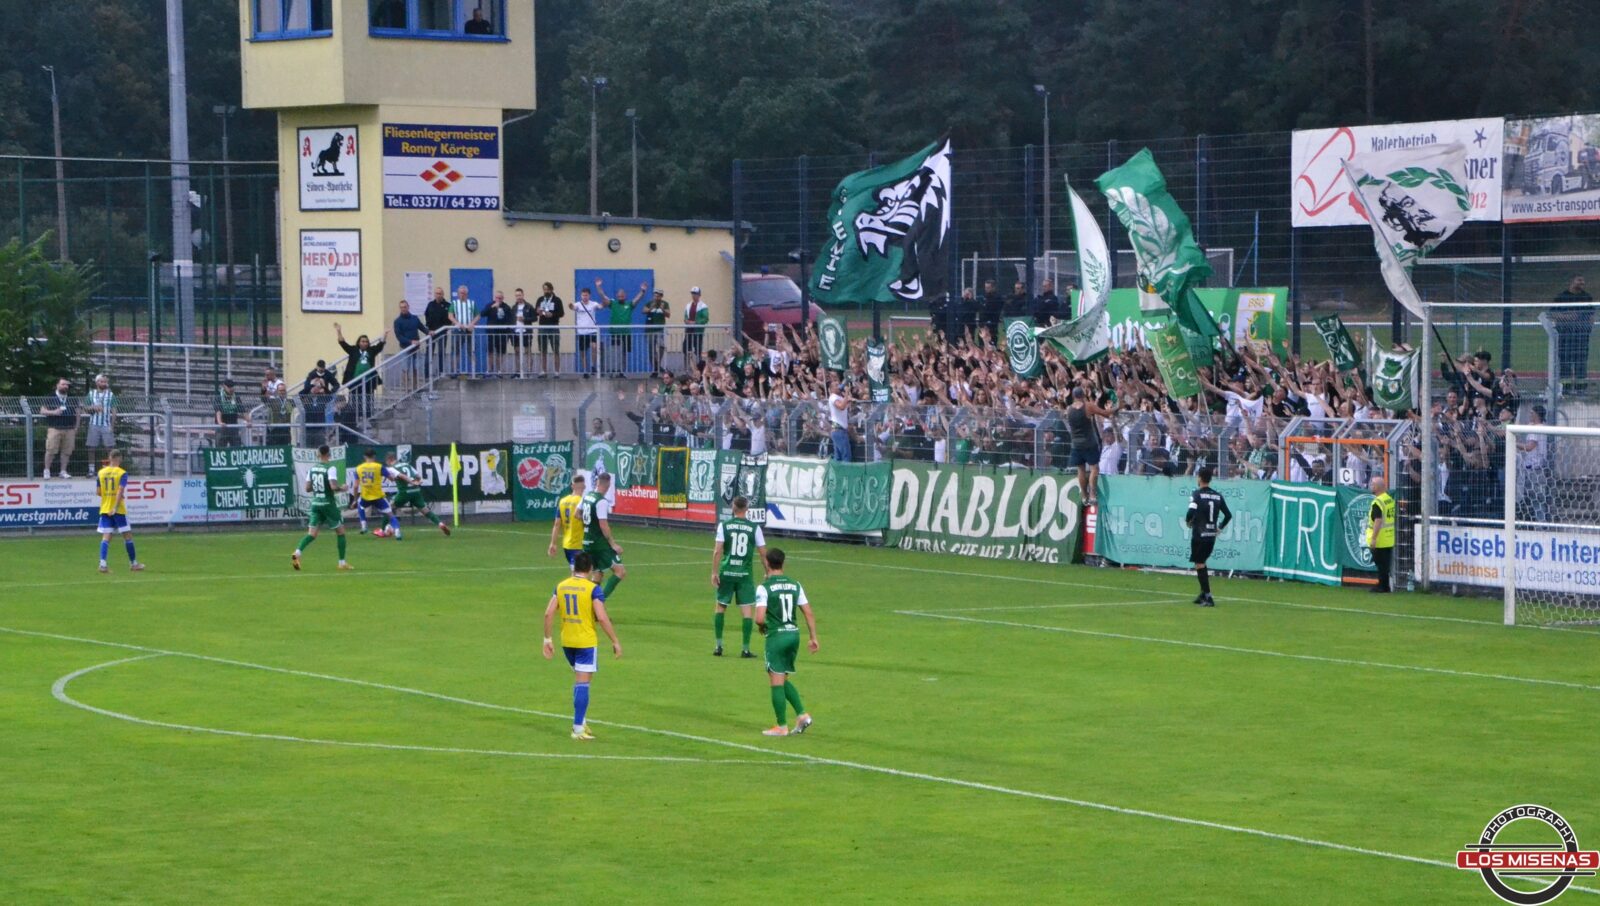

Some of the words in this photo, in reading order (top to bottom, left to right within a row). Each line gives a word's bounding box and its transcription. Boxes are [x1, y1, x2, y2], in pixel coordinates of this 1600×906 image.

[384, 126, 497, 142] Fliesenlegermeister
[401, 142, 437, 158] Ronny
[440, 143, 480, 159] Körtge
[385, 195, 409, 208] Tel.:
[411, 196, 449, 209] 03371/
[451, 197, 465, 208] 64
[467, 197, 482, 209] 29
[483, 198, 498, 209] 99
[210, 450, 228, 467] LAS
[230, 448, 286, 466] CUCARACHAS
[361, 471, 375, 485] 24
[415, 454, 480, 487] GWP
[1342, 469, 1352, 483] C
[103, 477, 116, 491] 11
[184, 480, 202, 488] Holt
[311, 473, 326, 492] 39
[215, 490, 249, 508] CHEMIE
[252, 488, 286, 506] LEIPZIG
[889, 468, 1081, 541] DIABLOS
[1208, 500, 1215, 522] 1
[730, 532, 749, 557] 18
[1437, 560, 1498, 580] Lufthansa
[1527, 566, 1564, 584] Center
[564, 594, 578, 615] 11
